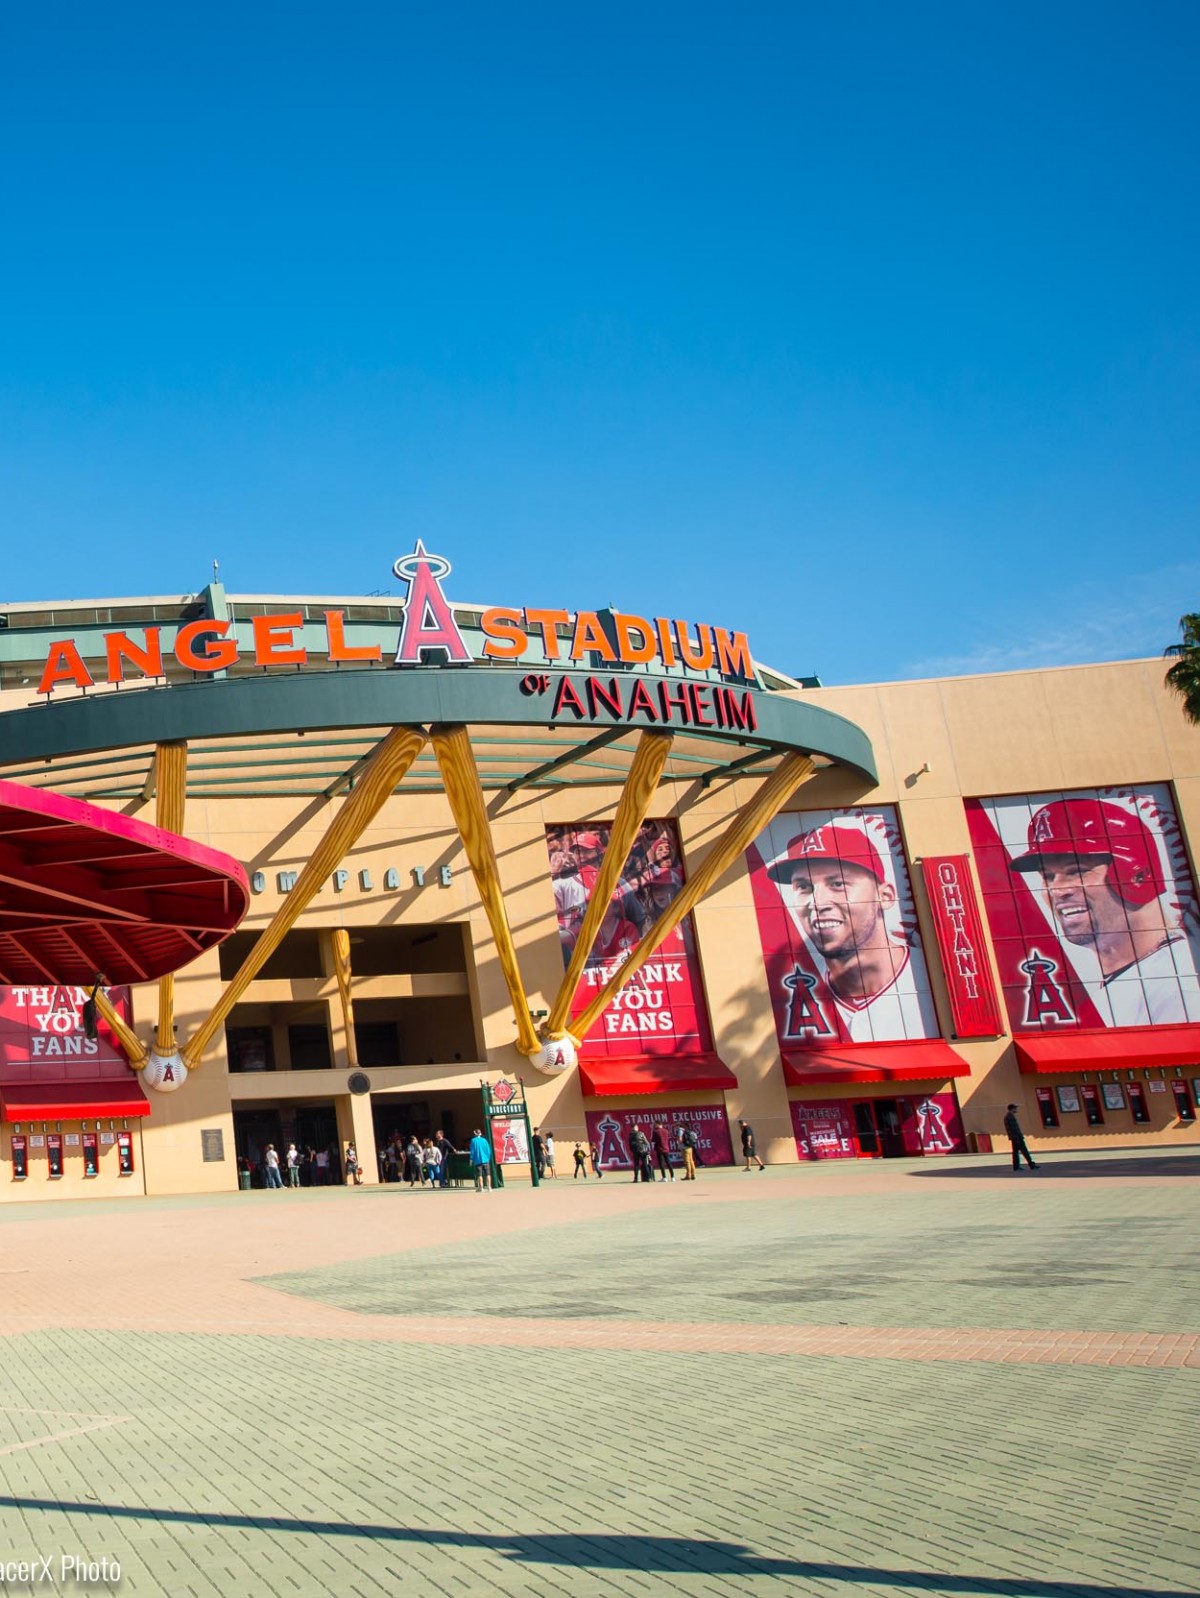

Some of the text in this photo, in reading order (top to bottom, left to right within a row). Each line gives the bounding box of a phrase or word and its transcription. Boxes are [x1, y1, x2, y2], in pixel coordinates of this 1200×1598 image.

[36, 610, 383, 694] ANGEL
[481, 607, 755, 680] STADIUM
[521, 673, 758, 732] OF ANAHEIM
[334, 864, 453, 892] PLATE
[938, 863, 979, 999] OHTANI
[612, 990, 663, 1010] YOU
[605, 1011, 674, 1033] FANS
[32, 1036, 99, 1056] FANS
[489, 1104, 522, 1114] DIRECTORY
[625, 1110, 723, 1125] STADIUM EXCLUSIVE
[810, 1131, 837, 1145] SALE
